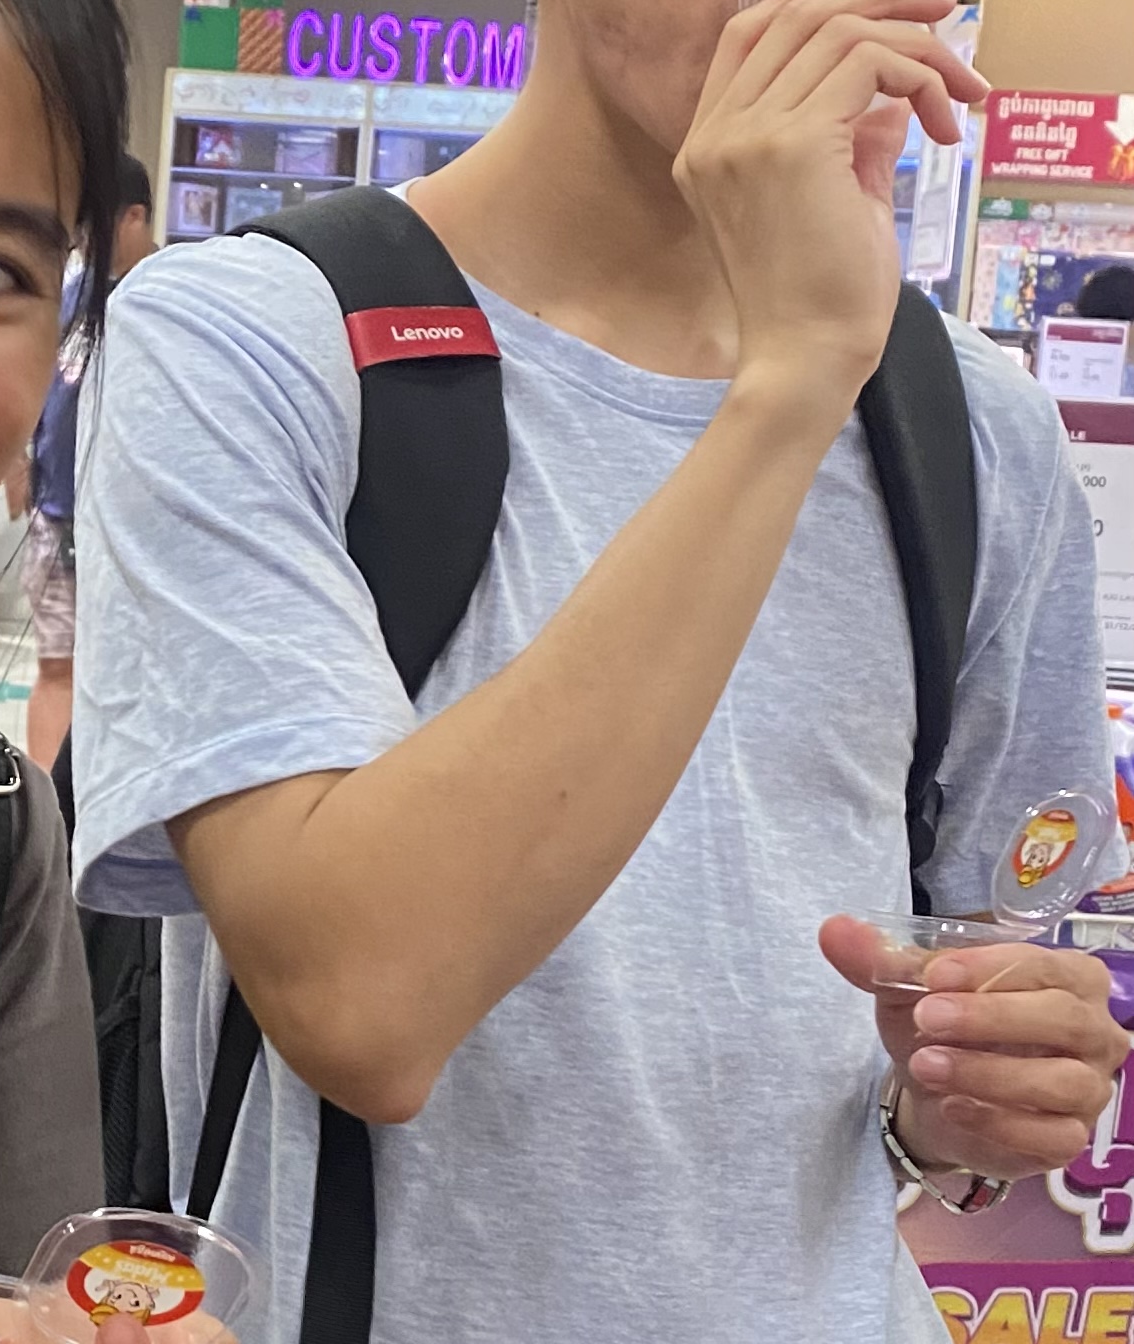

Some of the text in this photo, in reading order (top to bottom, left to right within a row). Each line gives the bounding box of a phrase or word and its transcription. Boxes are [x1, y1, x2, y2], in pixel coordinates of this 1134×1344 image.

[288, 9, 526, 90] CUSTOM
[1017, 147, 1069, 162] FREE GIFT
[991, 162, 1094, 179] WRAPPING SERVICE
[391, 326, 464, 341] Lenovo
